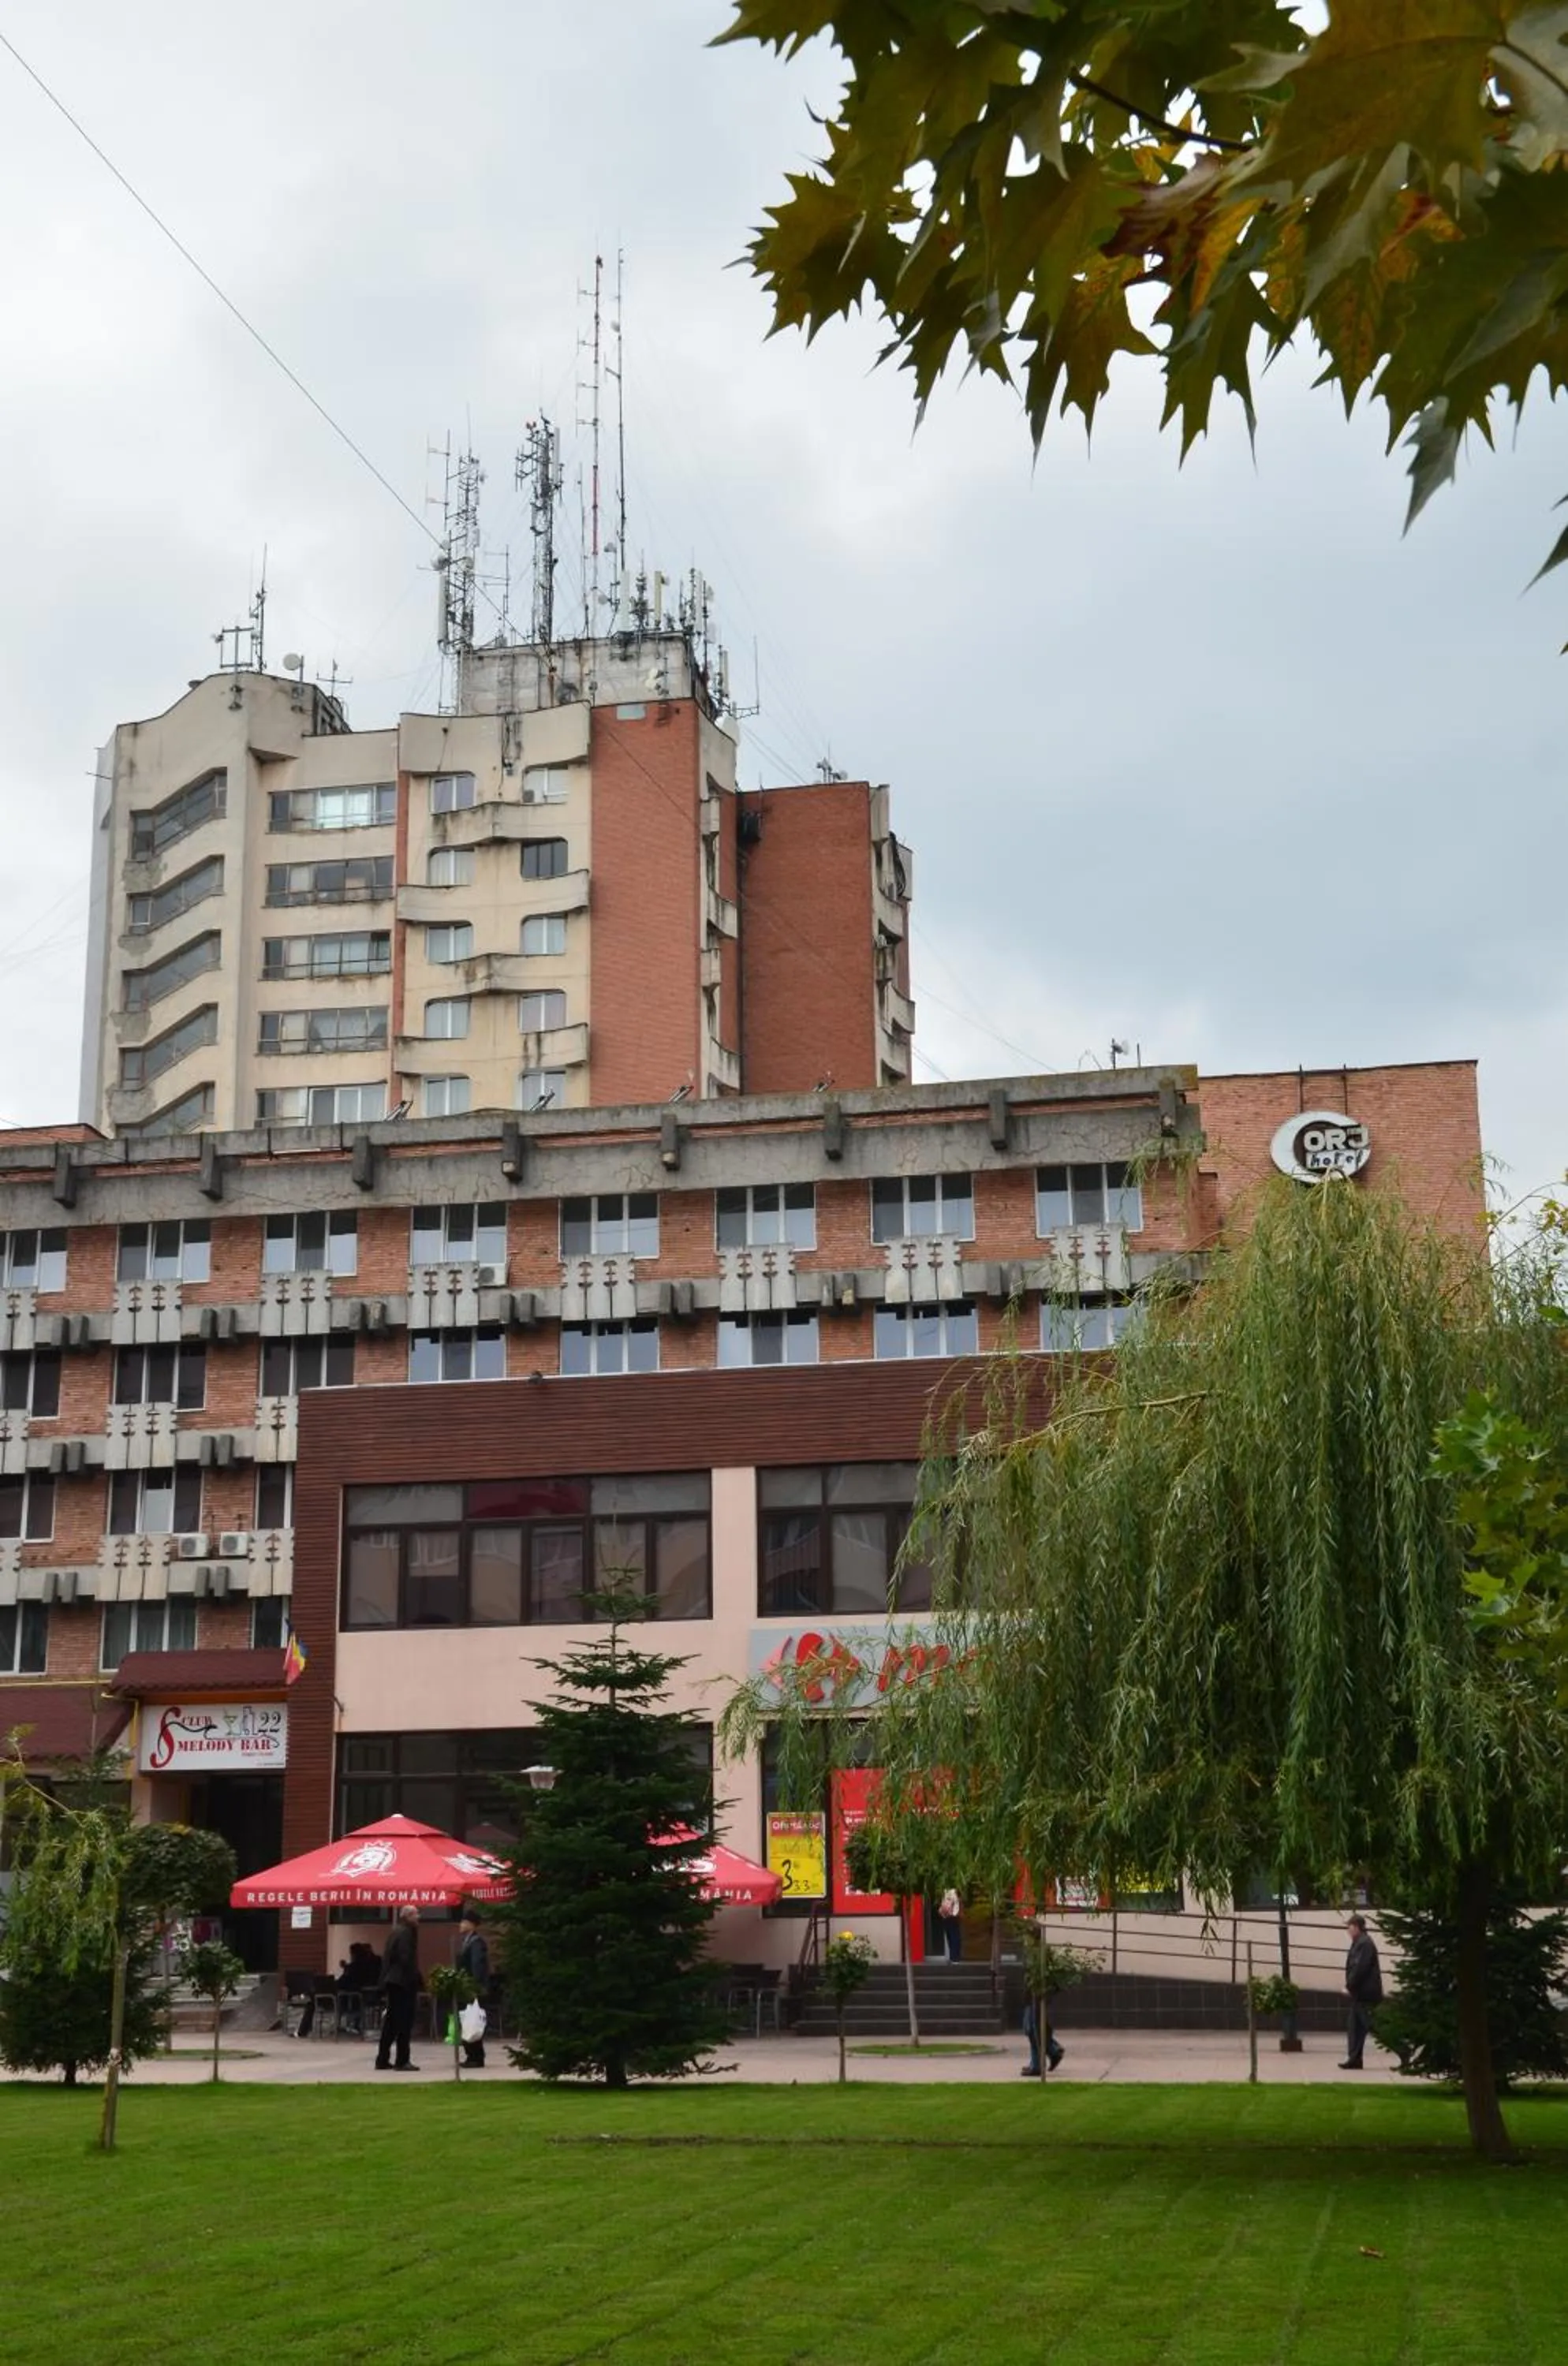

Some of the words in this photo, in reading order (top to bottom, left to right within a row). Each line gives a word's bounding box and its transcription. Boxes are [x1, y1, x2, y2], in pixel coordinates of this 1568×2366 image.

[257, 1711, 282, 1733] 22
[177, 1738, 233, 1752] MELODY
[241, 1737, 271, 1750] BAR
[246, 1891, 304, 1902] REGELE
[309, 1890, 351, 1902] BERII
[356, 1886, 372, 1901] ÎN
[377, 1887, 448, 1902] ROMÂNIA
